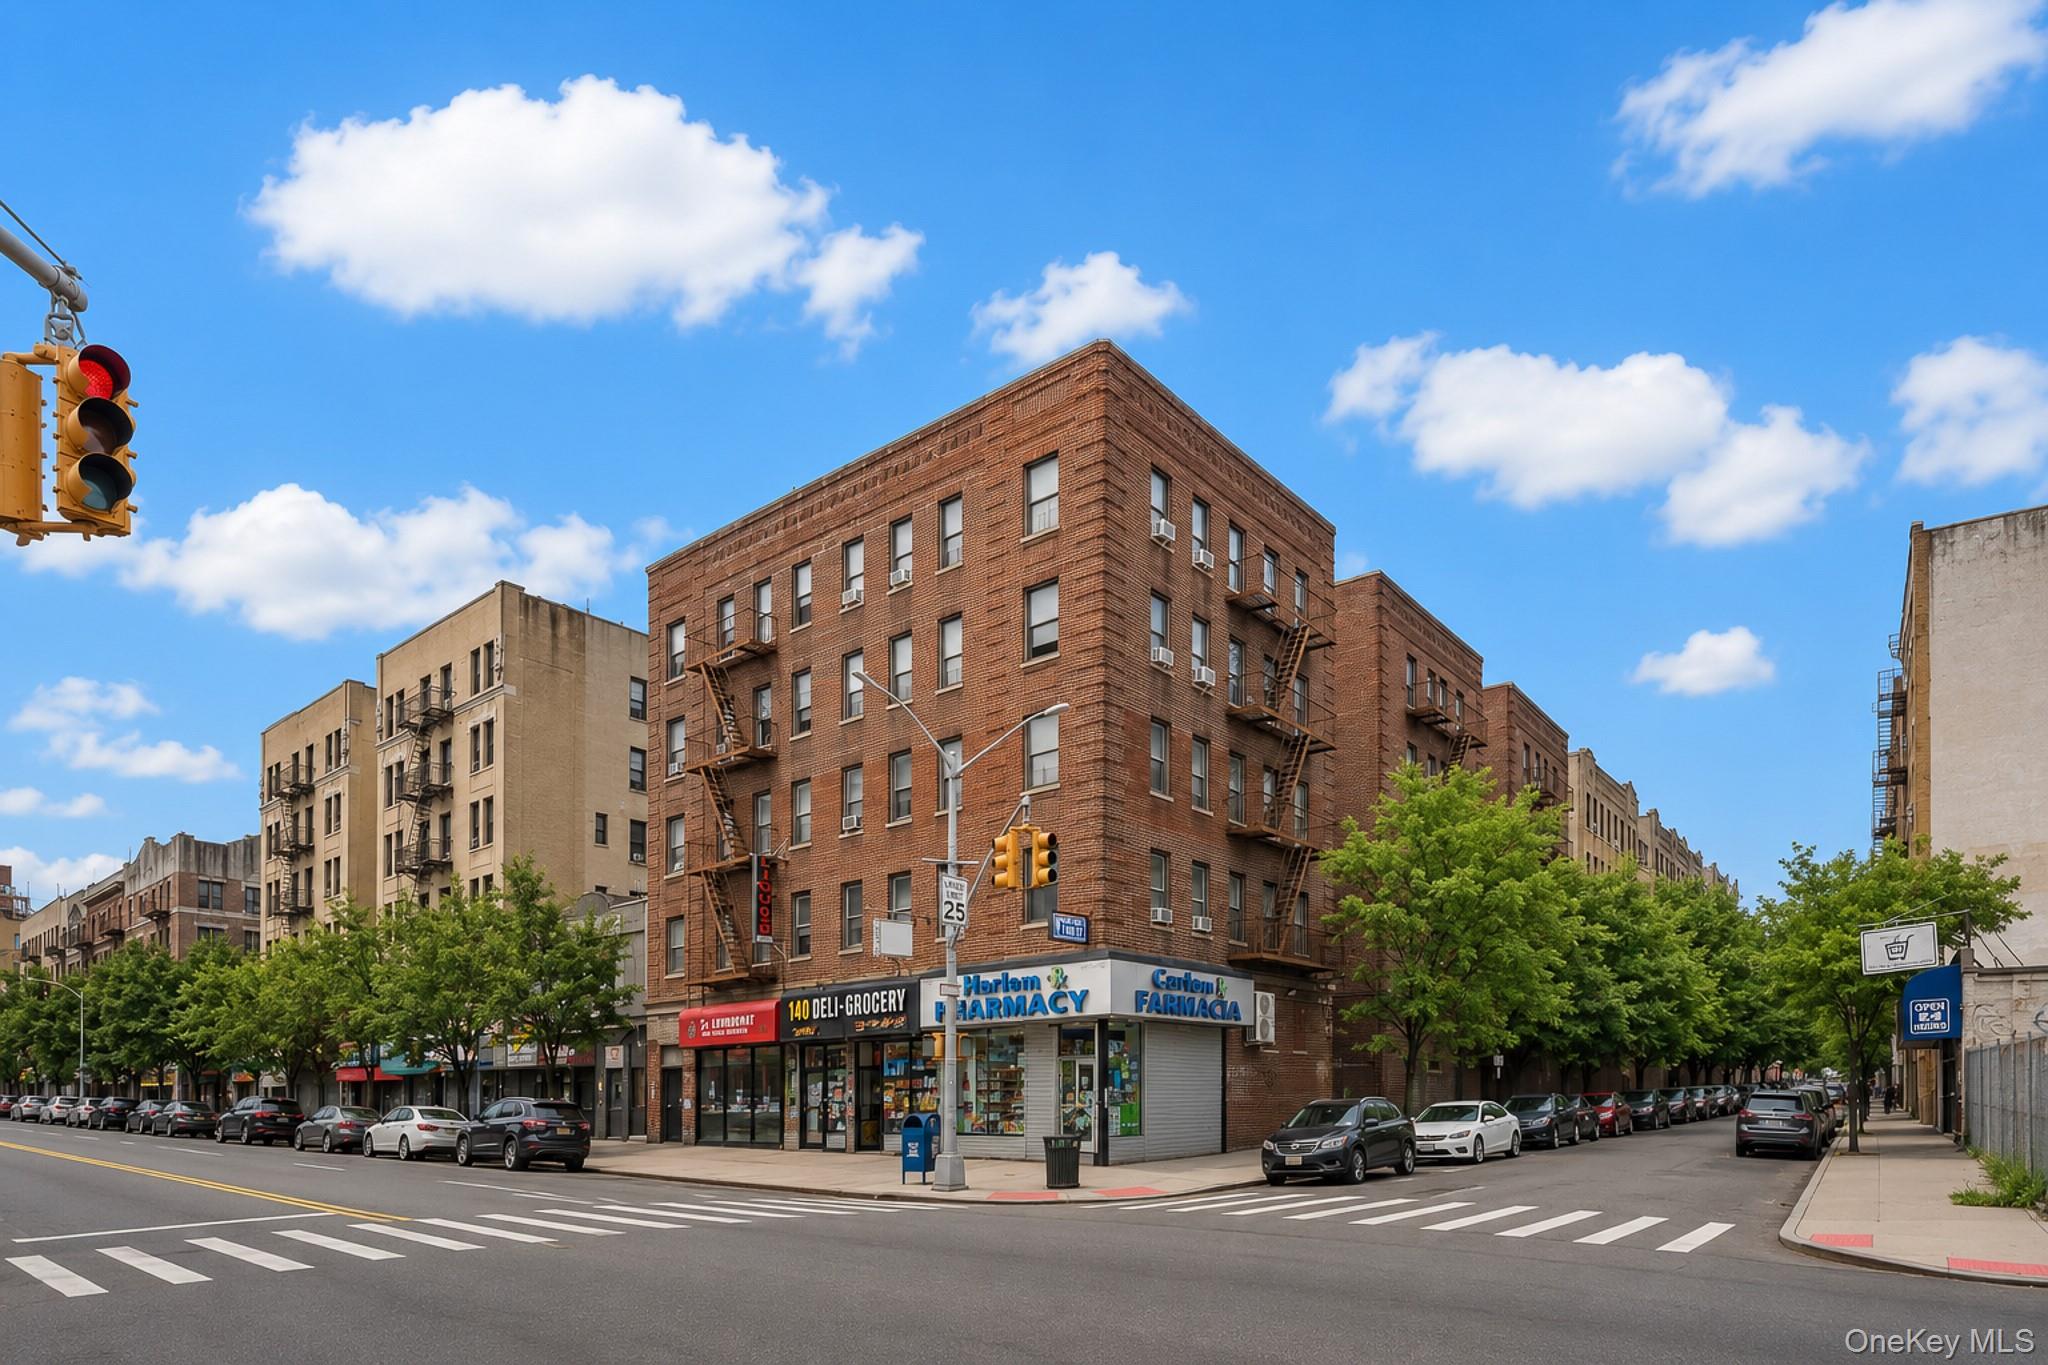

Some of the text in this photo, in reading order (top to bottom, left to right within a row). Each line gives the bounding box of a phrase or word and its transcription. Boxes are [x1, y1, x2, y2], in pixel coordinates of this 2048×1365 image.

[944, 901, 965, 922] 25
[788, 999, 810, 1022] 140
[1135, 990, 1242, 1021] FARMACIA
